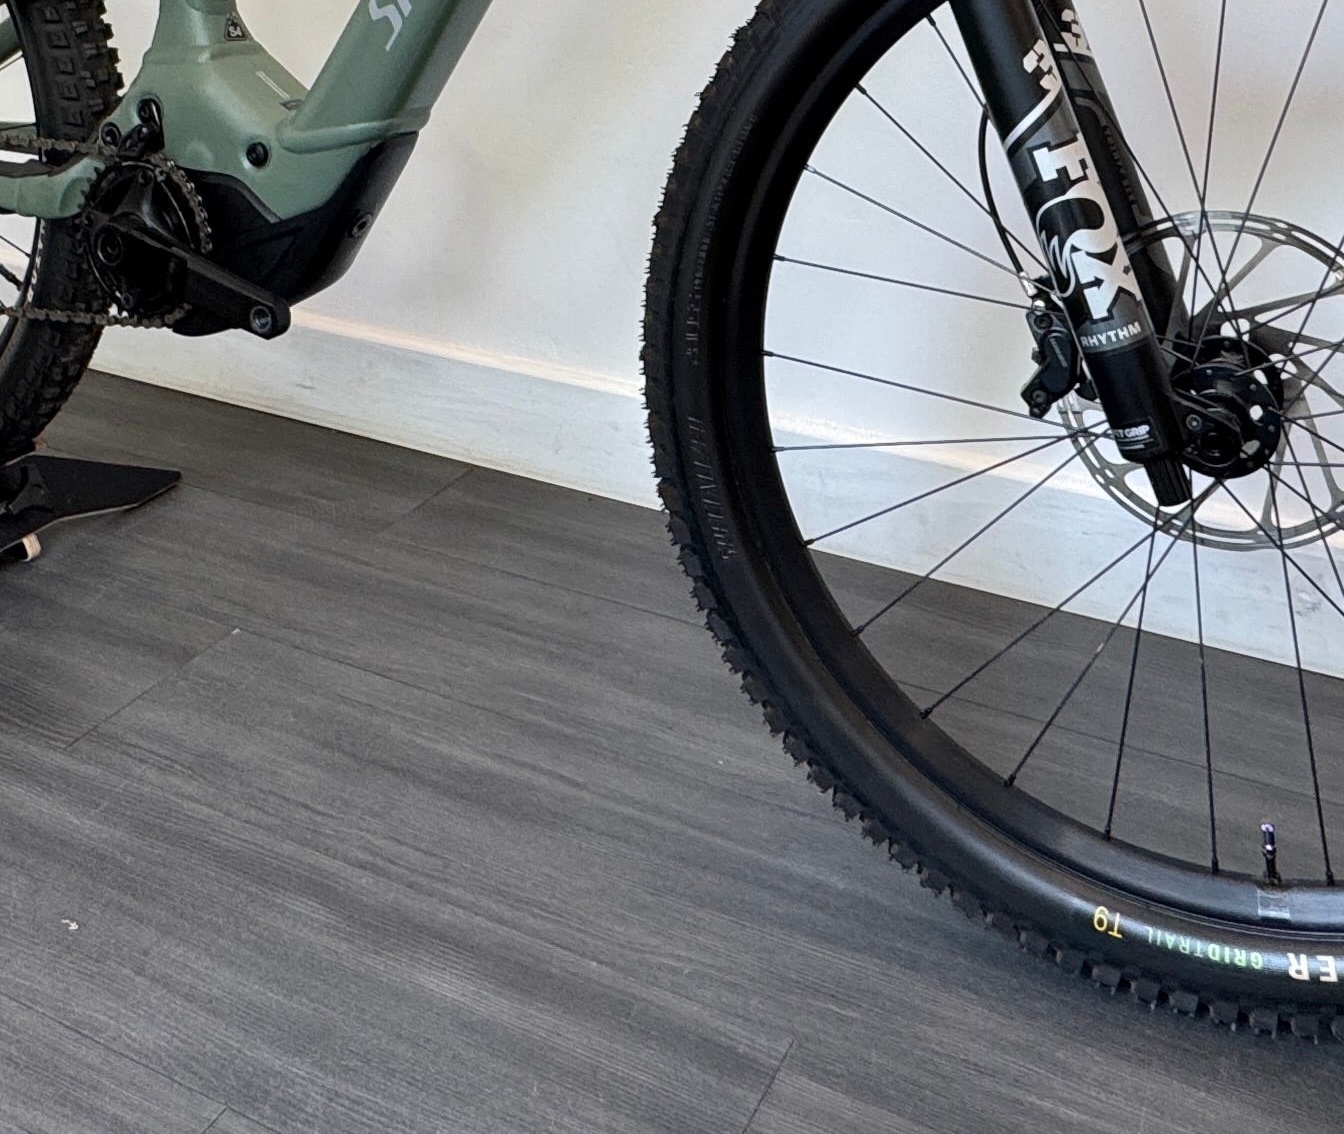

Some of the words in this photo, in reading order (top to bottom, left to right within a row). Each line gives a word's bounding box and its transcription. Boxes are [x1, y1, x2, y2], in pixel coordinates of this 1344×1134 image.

[1032, 132, 1144, 320] FOX
[1080, 321, 1142, 347] RHYTHM
[1093, 905, 1124, 939] T9
